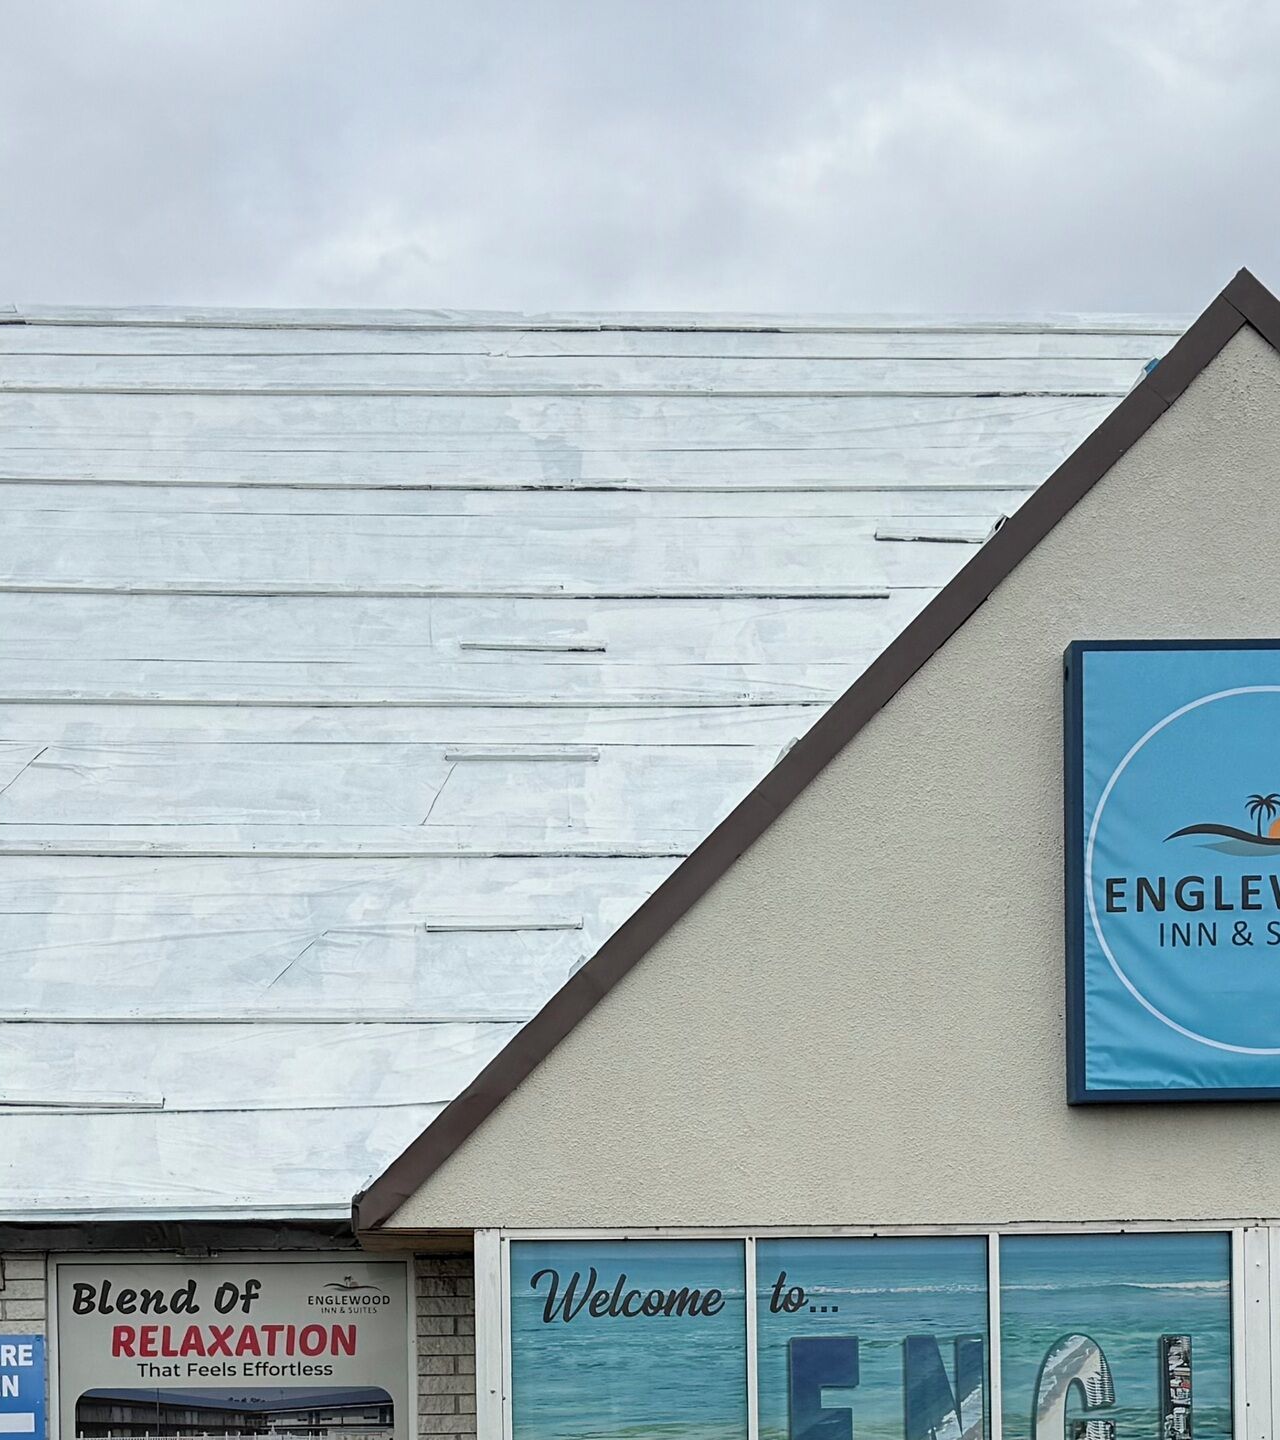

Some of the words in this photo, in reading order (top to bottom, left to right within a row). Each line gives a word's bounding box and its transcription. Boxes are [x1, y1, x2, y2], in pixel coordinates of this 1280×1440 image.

[1159, 922, 1218, 947] INN
[1231, 921, 1254, 946] &
[72, 1280, 200, 1316] Blend
[213, 1279, 262, 1314] Of
[308, 1296, 390, 1305] ENGLEWOOD
[530, 1268, 725, 1323] Welcome
[111, 1324, 357, 1358] RELAXATION
[137, 1363, 181, 1378] That
[187, 1362, 238, 1377] Feels
[244, 1360, 333, 1378] Effortless
